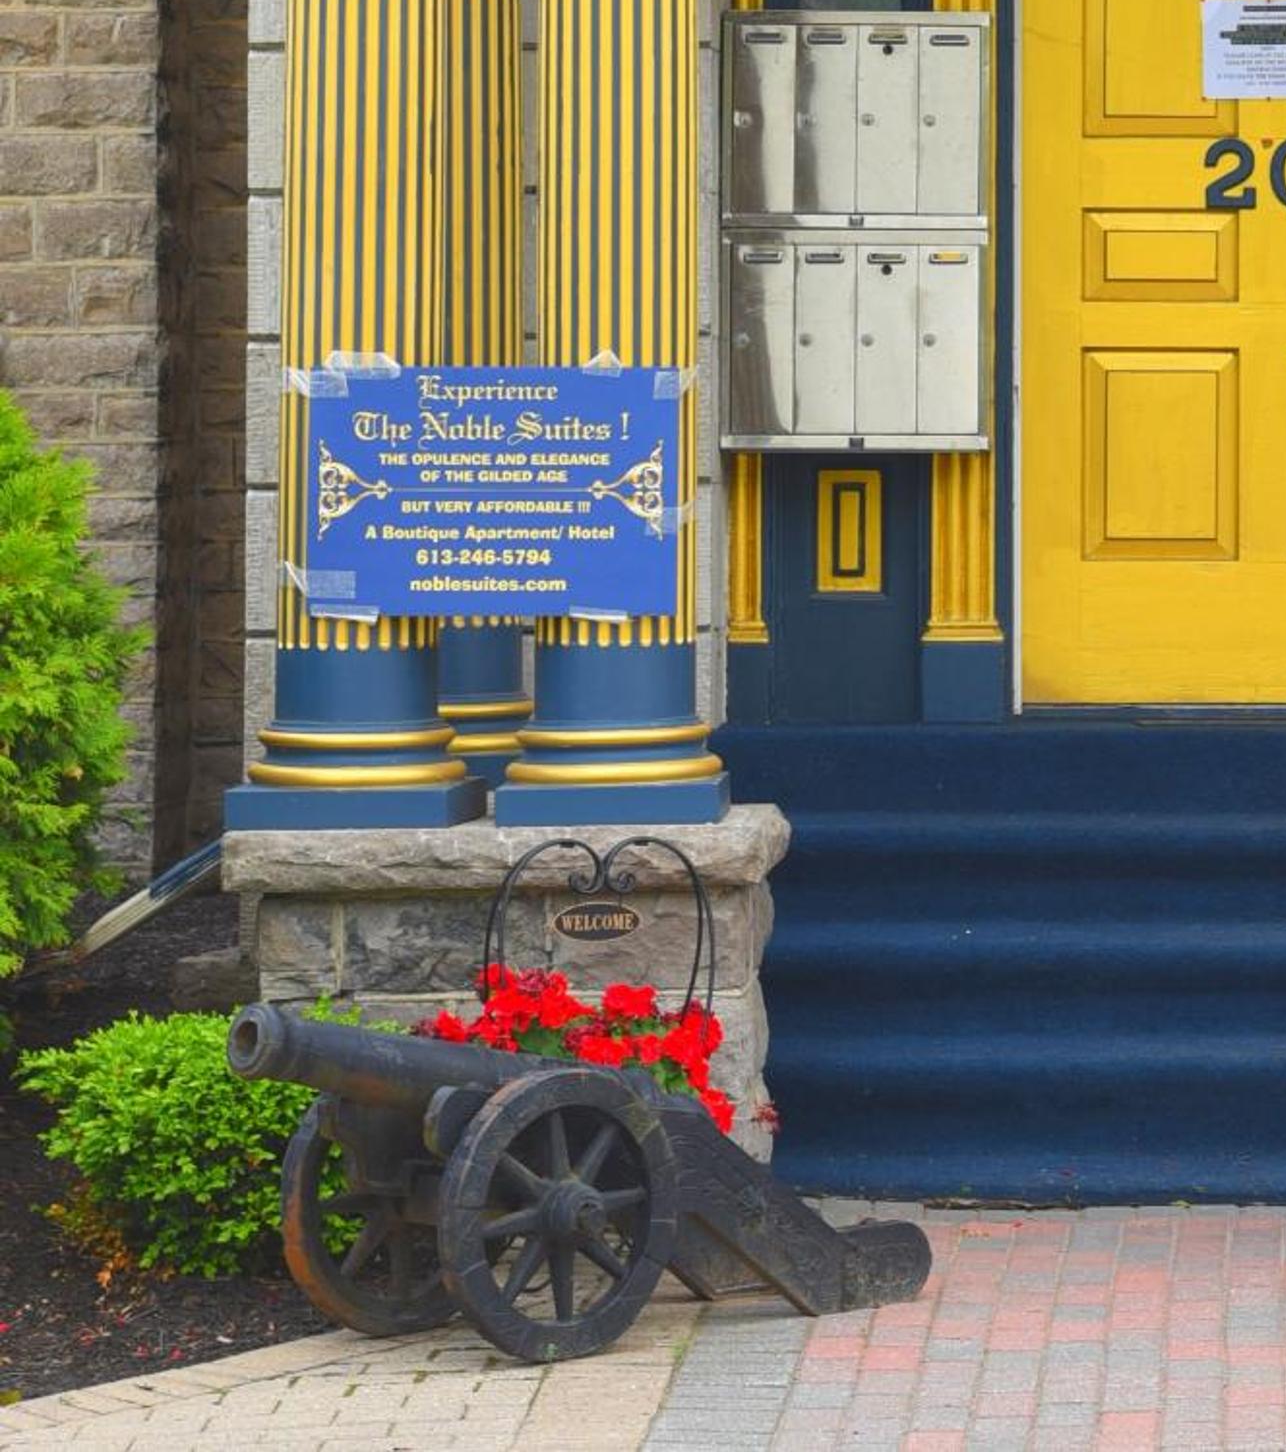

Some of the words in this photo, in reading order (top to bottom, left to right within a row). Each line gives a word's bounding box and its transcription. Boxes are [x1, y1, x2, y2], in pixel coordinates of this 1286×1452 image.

[417, 374, 558, 409] Experience
[352, 411, 412, 447] The
[418, 411, 505, 449] Noble
[507, 411, 611, 445] Suites
[378, 452, 408, 466] THE
[411, 452, 493, 466] OPULENCE
[496, 452, 527, 466] AND
[531, 452, 610, 466] ELEGANCE
[419, 469, 441, 483] OF
[444, 469, 475, 483] THE
[477, 469, 533, 483] GILDED
[536, 469, 569, 483] AGE
[401, 500, 432, 514] BUT
[434, 500, 473, 514] VERY
[476, 500, 574, 514] AFFORDABLE
[364, 525, 378, 540] A
[382, 525, 461, 541] Boutique
[464, 525, 564, 541] Apartment/
[567, 525, 615, 540] Hotel
[415, 548, 552, 566] 613-246-5794
[409, 576, 567, 592] noblesuites.com
[561, 913, 634, 932] WELCOME
